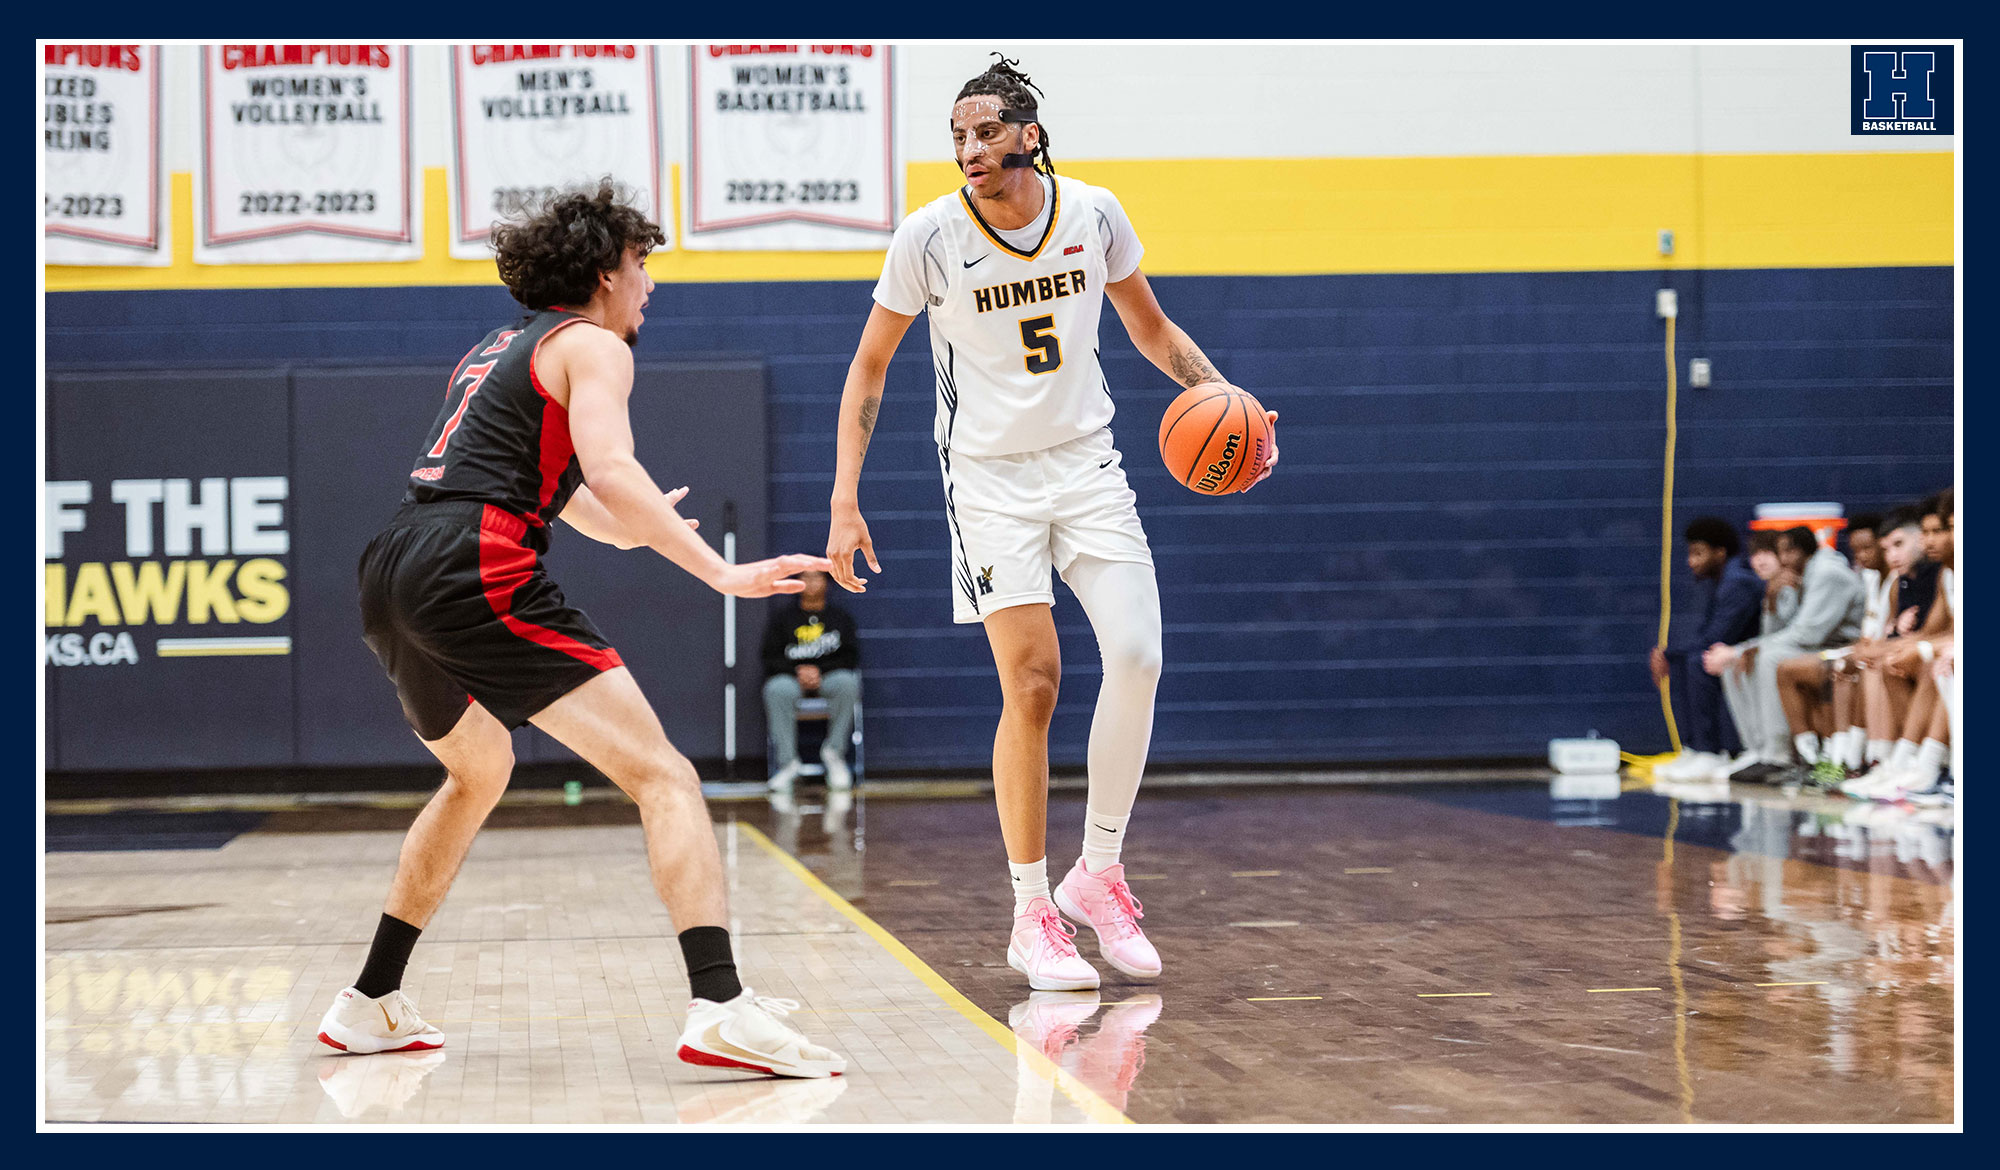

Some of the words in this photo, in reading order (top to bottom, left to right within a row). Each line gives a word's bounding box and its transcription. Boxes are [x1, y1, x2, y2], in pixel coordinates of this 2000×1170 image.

[249, 76, 367, 97] WOMEN'S
[517, 68, 594, 91] MEN'S
[732, 64, 849, 85] WOMEN'S
[232, 102, 384, 123] VOLLEYBALL
[481, 92, 632, 119] VOLLEYBALL
[716, 89, 867, 113] BASKETBALL
[239, 191, 377, 216] 2022-2023
[726, 180, 861, 205] 2022-2023
[972, 269, 1087, 313] HUMBER
[1018, 312, 1064, 376] 5
[426, 358, 499, 458] 7
[1194, 432, 1242, 491] Wilson
[1238, 438, 1264, 487] OLUTION
[111, 476, 290, 557] THE
